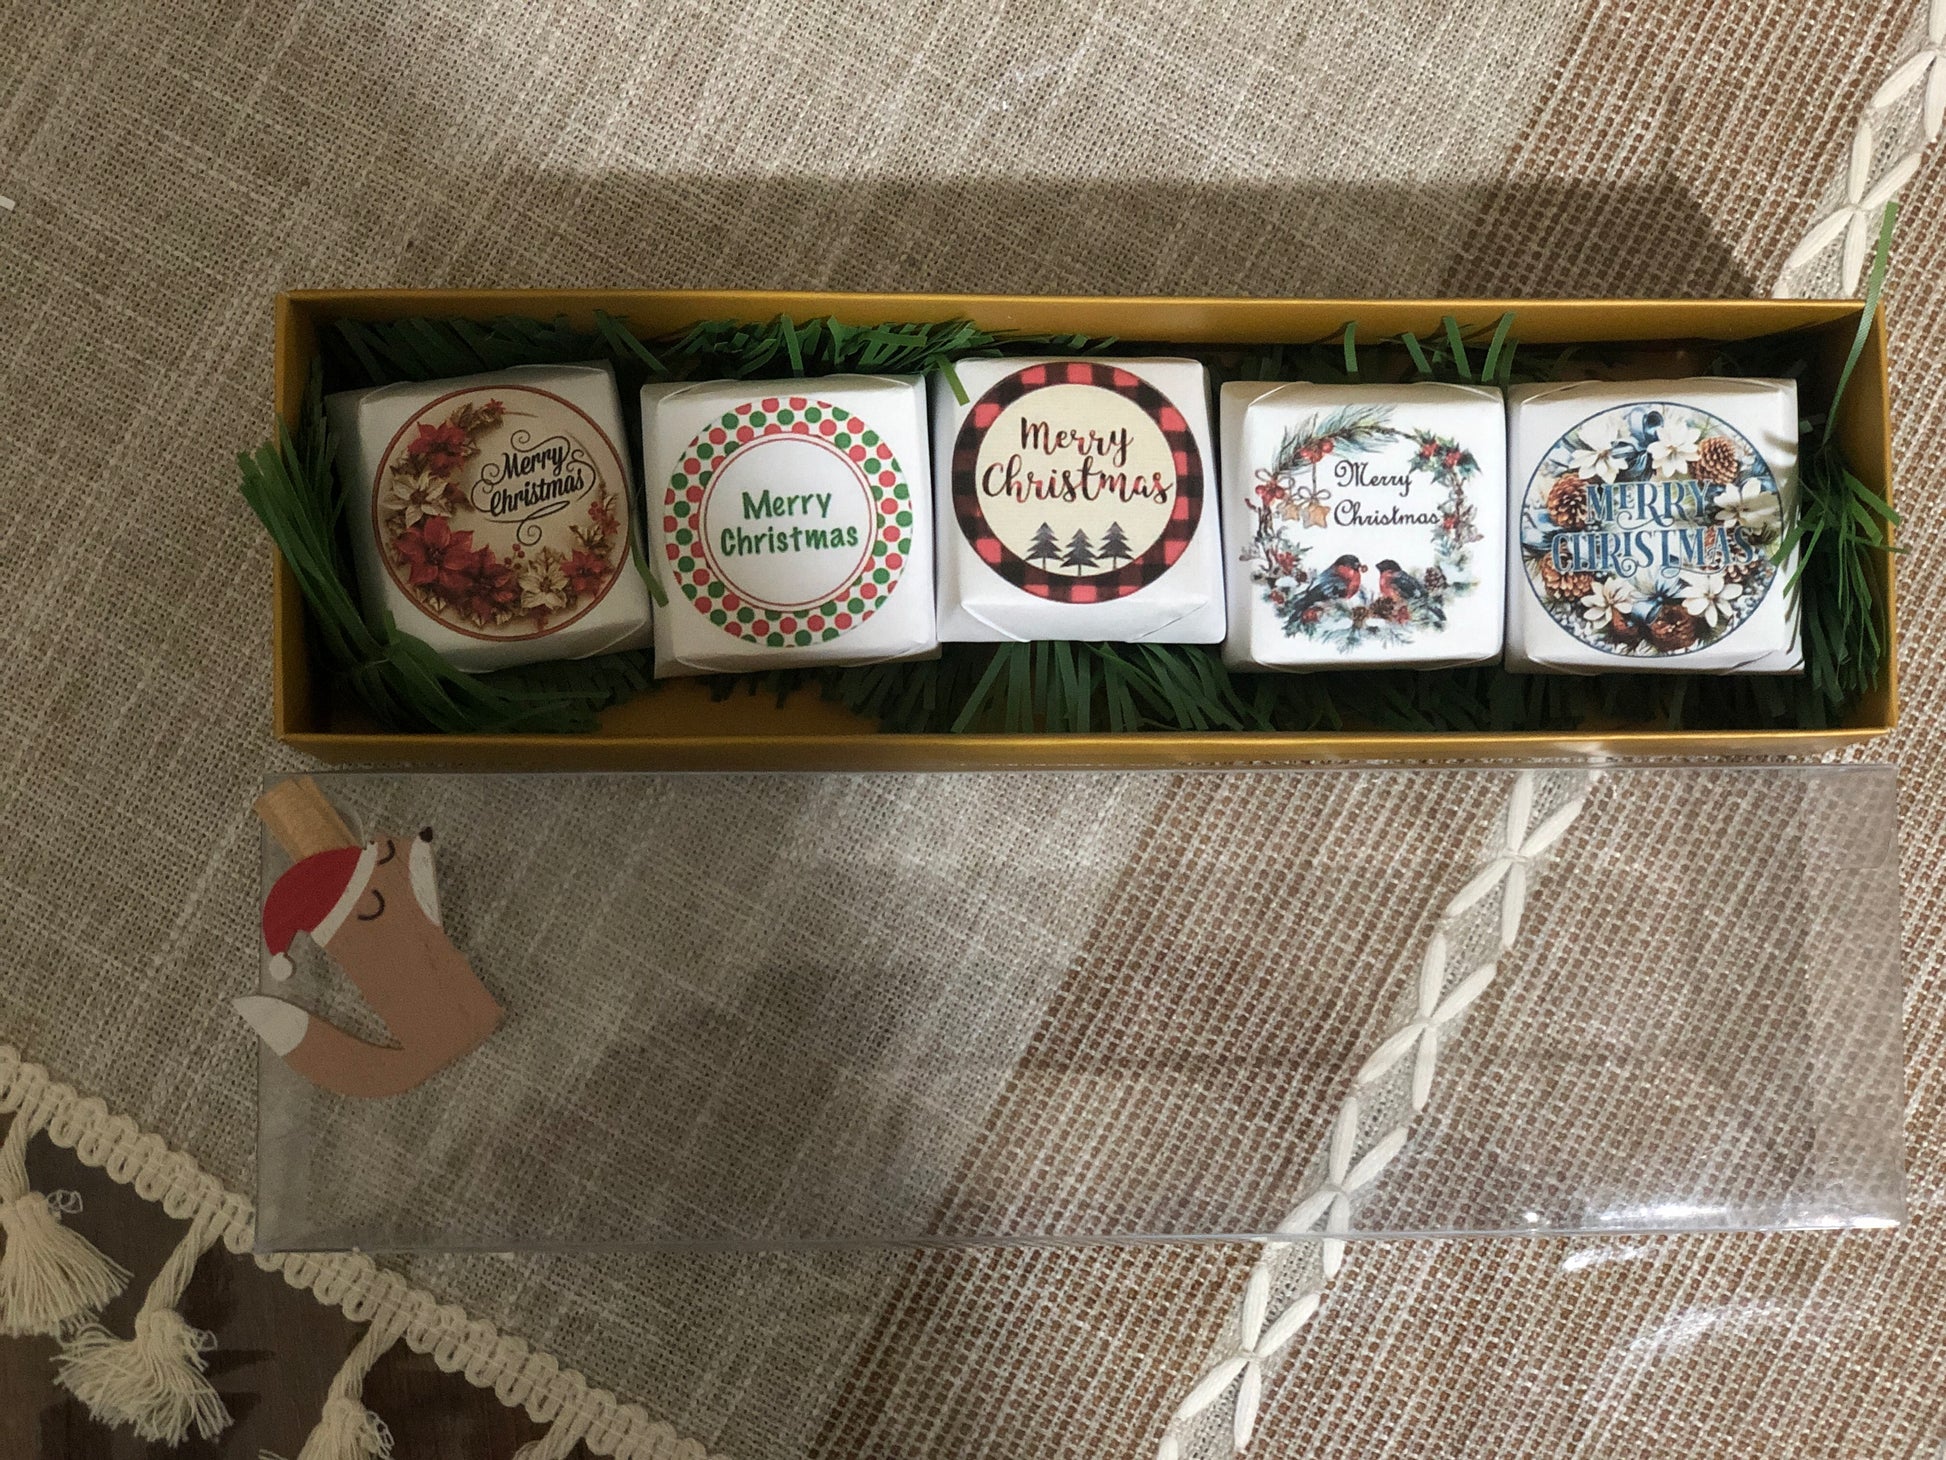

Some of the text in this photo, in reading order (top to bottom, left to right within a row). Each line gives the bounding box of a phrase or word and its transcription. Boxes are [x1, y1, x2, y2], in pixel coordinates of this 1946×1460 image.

[498, 443, 569, 481] Merry
[1020, 416, 1134, 468] Merry
[487, 467, 587, 517] Christmas
[982, 454, 1173, 504] Christmas
[1334, 459, 1412, 497] Merry
[742, 489, 832, 520] Merry
[1333, 499, 1440, 526] Christmas
[1585, 479, 1713, 529] MERRY
[720, 526, 858, 556] Christmas
[1551, 525, 1756, 578] CHRISTMAS
